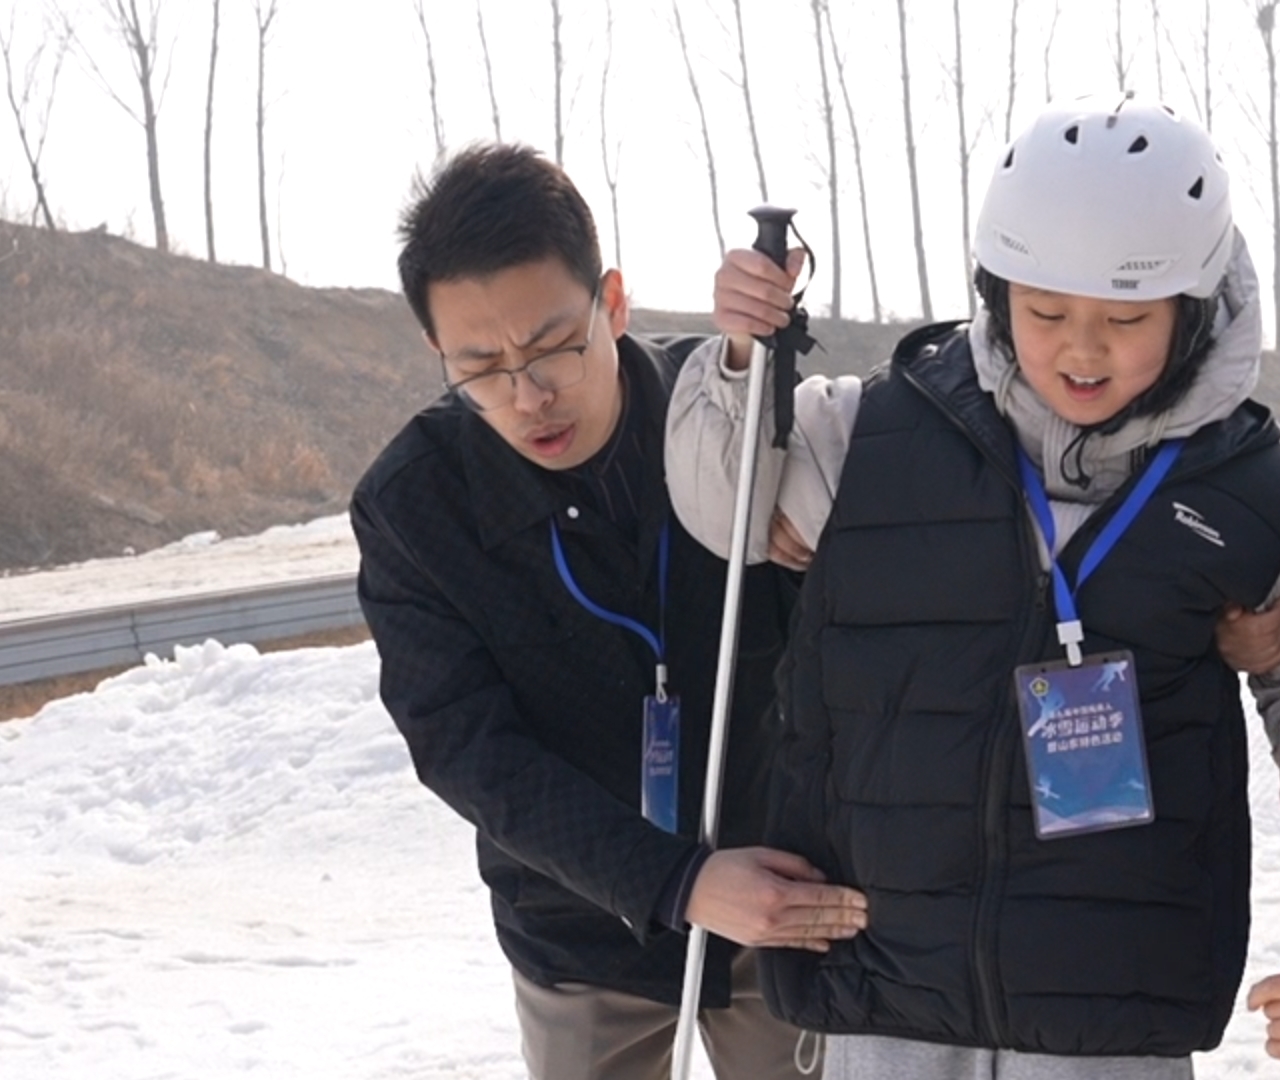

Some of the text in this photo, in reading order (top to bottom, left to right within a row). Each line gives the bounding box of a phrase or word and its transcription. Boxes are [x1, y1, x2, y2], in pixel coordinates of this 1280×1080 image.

[1041, 711, 1123, 739] 冰雪运动季
